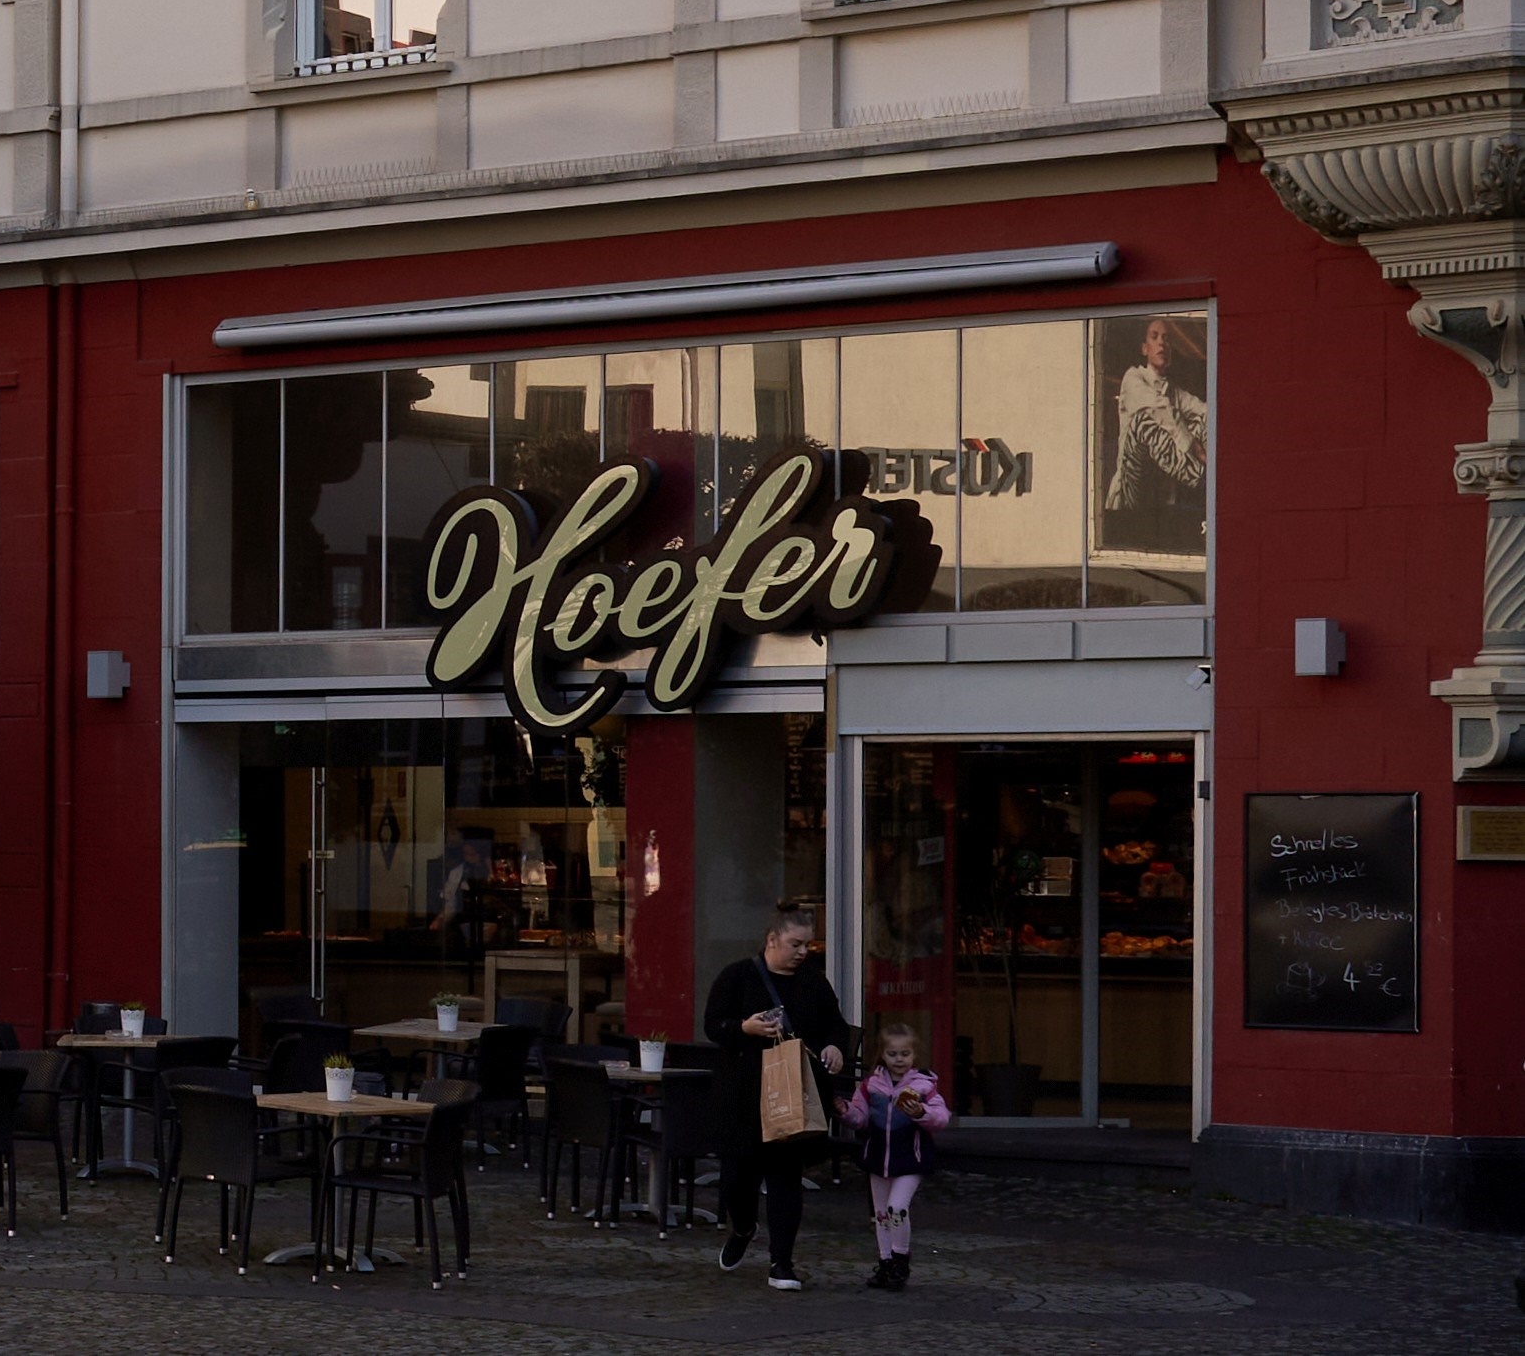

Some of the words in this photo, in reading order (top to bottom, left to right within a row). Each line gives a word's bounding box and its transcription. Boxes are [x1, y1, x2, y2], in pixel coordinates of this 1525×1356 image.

[426, 453, 879, 729] Hoefer
[1270, 829, 1359, 858] Schnelles
[1279, 861, 1367, 891] Frühstück
[1346, 902, 1413, 923] Brötchen
